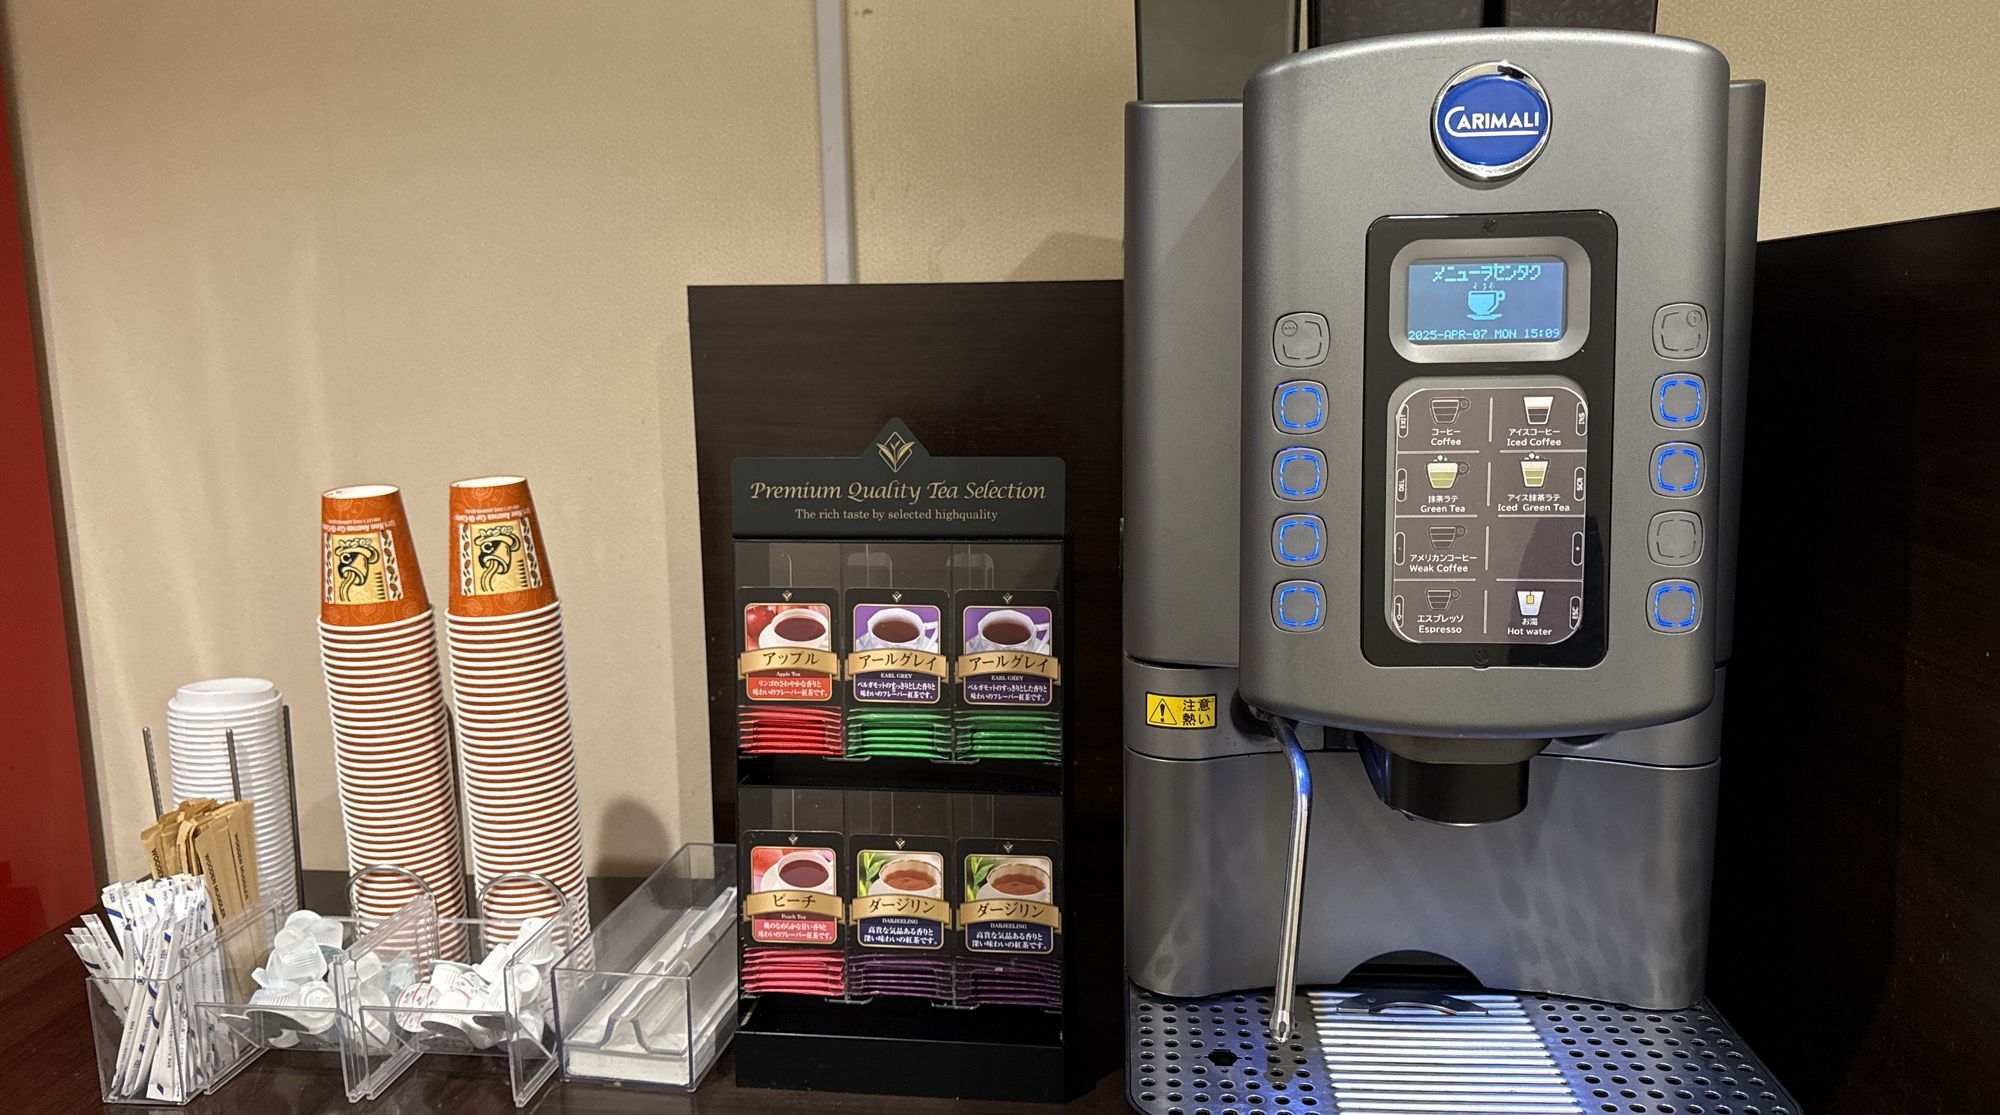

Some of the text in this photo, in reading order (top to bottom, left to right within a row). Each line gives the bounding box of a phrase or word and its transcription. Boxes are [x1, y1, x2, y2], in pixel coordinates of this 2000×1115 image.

[1444, 106, 1539, 137] CARIMALI
[1432, 263, 1542, 282] メニューヲセンタク
[1408, 328, 1560, 341] 2025-APR-07 MON 15:09
[1431, 428, 1461, 436] コーヒー
[1508, 428, 1561, 437] アイスコーヒー
[1430, 438, 1462, 446] Coffee
[1506, 438, 1562, 447] Iced Coffee
[750, 480, 1047, 504] Premium Quality Tea Selection
[1428, 495, 1459, 503] 抹茶ラテ
[1507, 494, 1561, 502] アイス抹茶ラテ
[1420, 505, 1466, 513] Green Tea
[1497, 504, 1570, 512] Iced Green Tea
[795, 508, 998, 522] The rich taste by selected highquality
[1409, 554, 1478, 562] アメリカンコーヒー
[1409, 564, 1469, 573] Weak Coffee
[1417, 614, 1464, 623] エスプレッソ
[1521, 618, 1538, 626] お湯
[1418, 626, 1463, 634] Espresso
[1507, 627, 1553, 636] Hot water
[762, 651, 820, 666] アップル
[858, 652, 937, 671] アールグレイ
[969, 654, 1049, 673] アールグレイ
[1182, 698, 1213, 712] 注意
[1182, 713, 1211, 726] 熱い
[772, 894, 816, 909] ピーチ
[869, 897, 936, 914] ダージリン
[976, 902, 1045, 918] ダージリン
